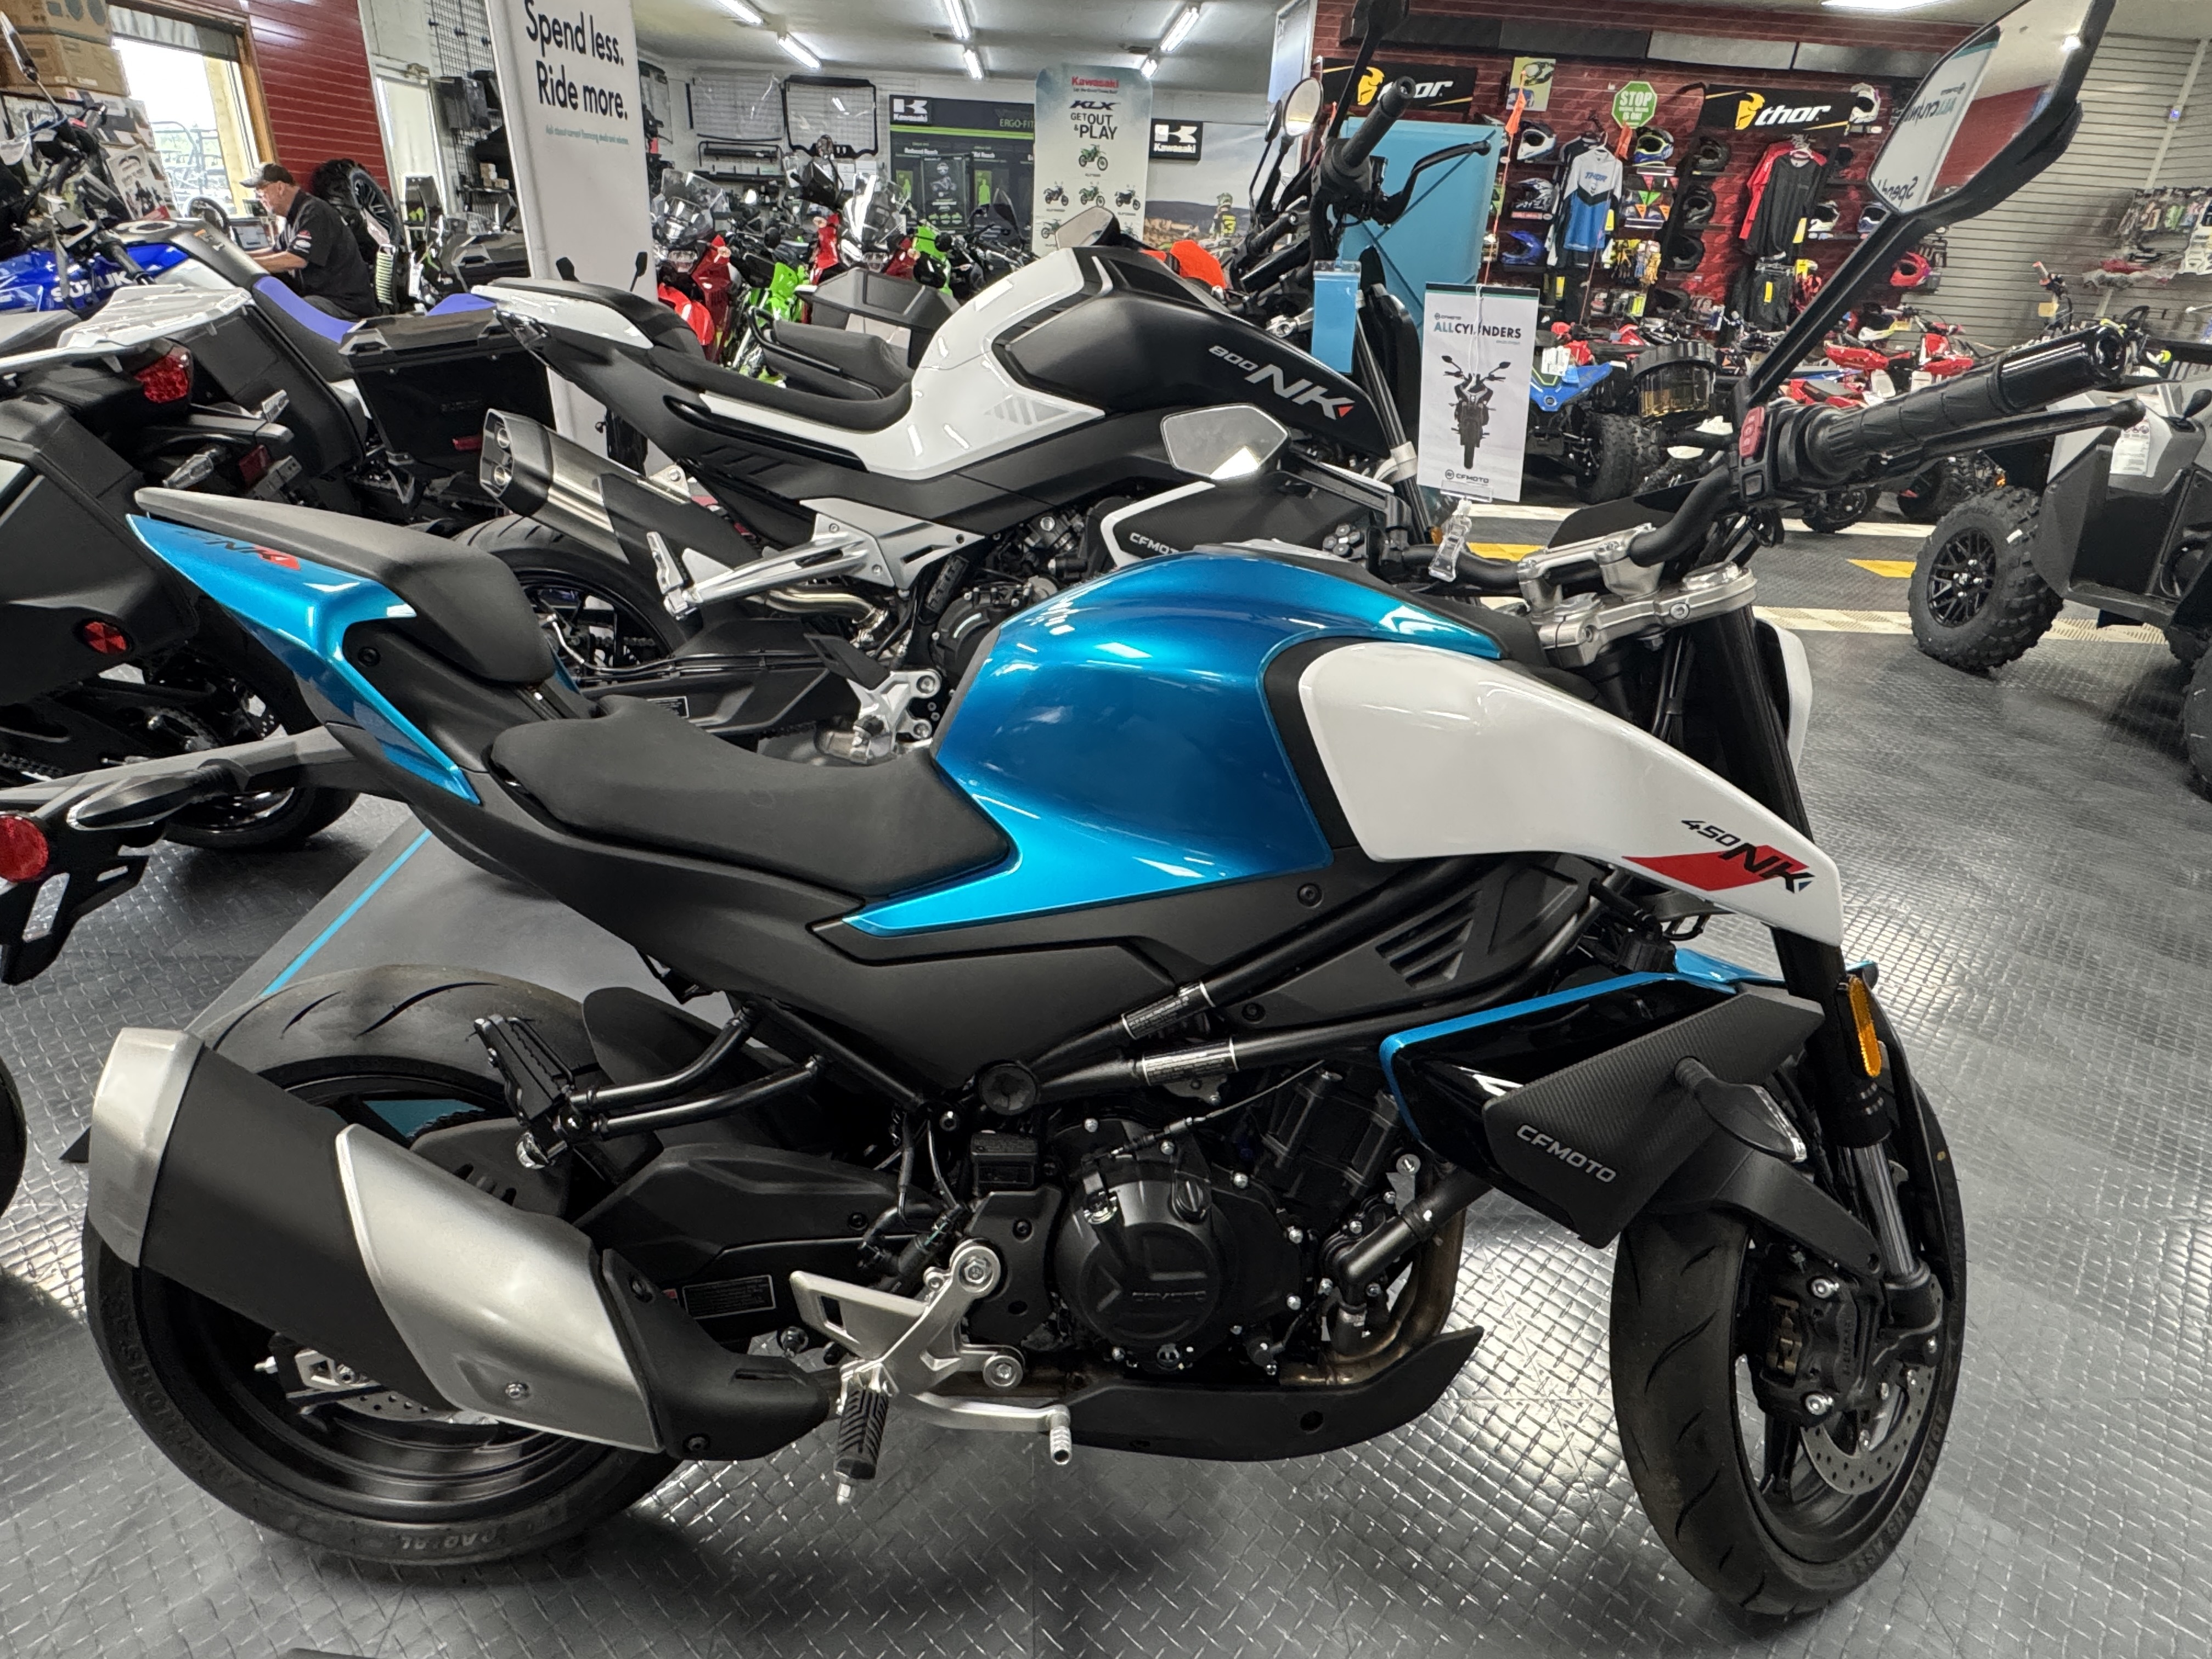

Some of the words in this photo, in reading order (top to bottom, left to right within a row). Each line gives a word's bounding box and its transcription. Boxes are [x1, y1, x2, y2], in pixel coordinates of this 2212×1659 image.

[524, 0, 586, 57] Spend
[589, 14, 624, 66] less.
[536, 59, 579, 110] Ride
[583, 85, 628, 120] more.
[1069, 100, 1116, 110] KLX
[1620, 90, 1652, 106] STOP
[1070, 112, 1087, 122] GET
[1087, 113, 1113, 125] OUT
[1079, 125, 1118, 140] PLAY
[1516, 1125, 1617, 1183] CFMOTO
